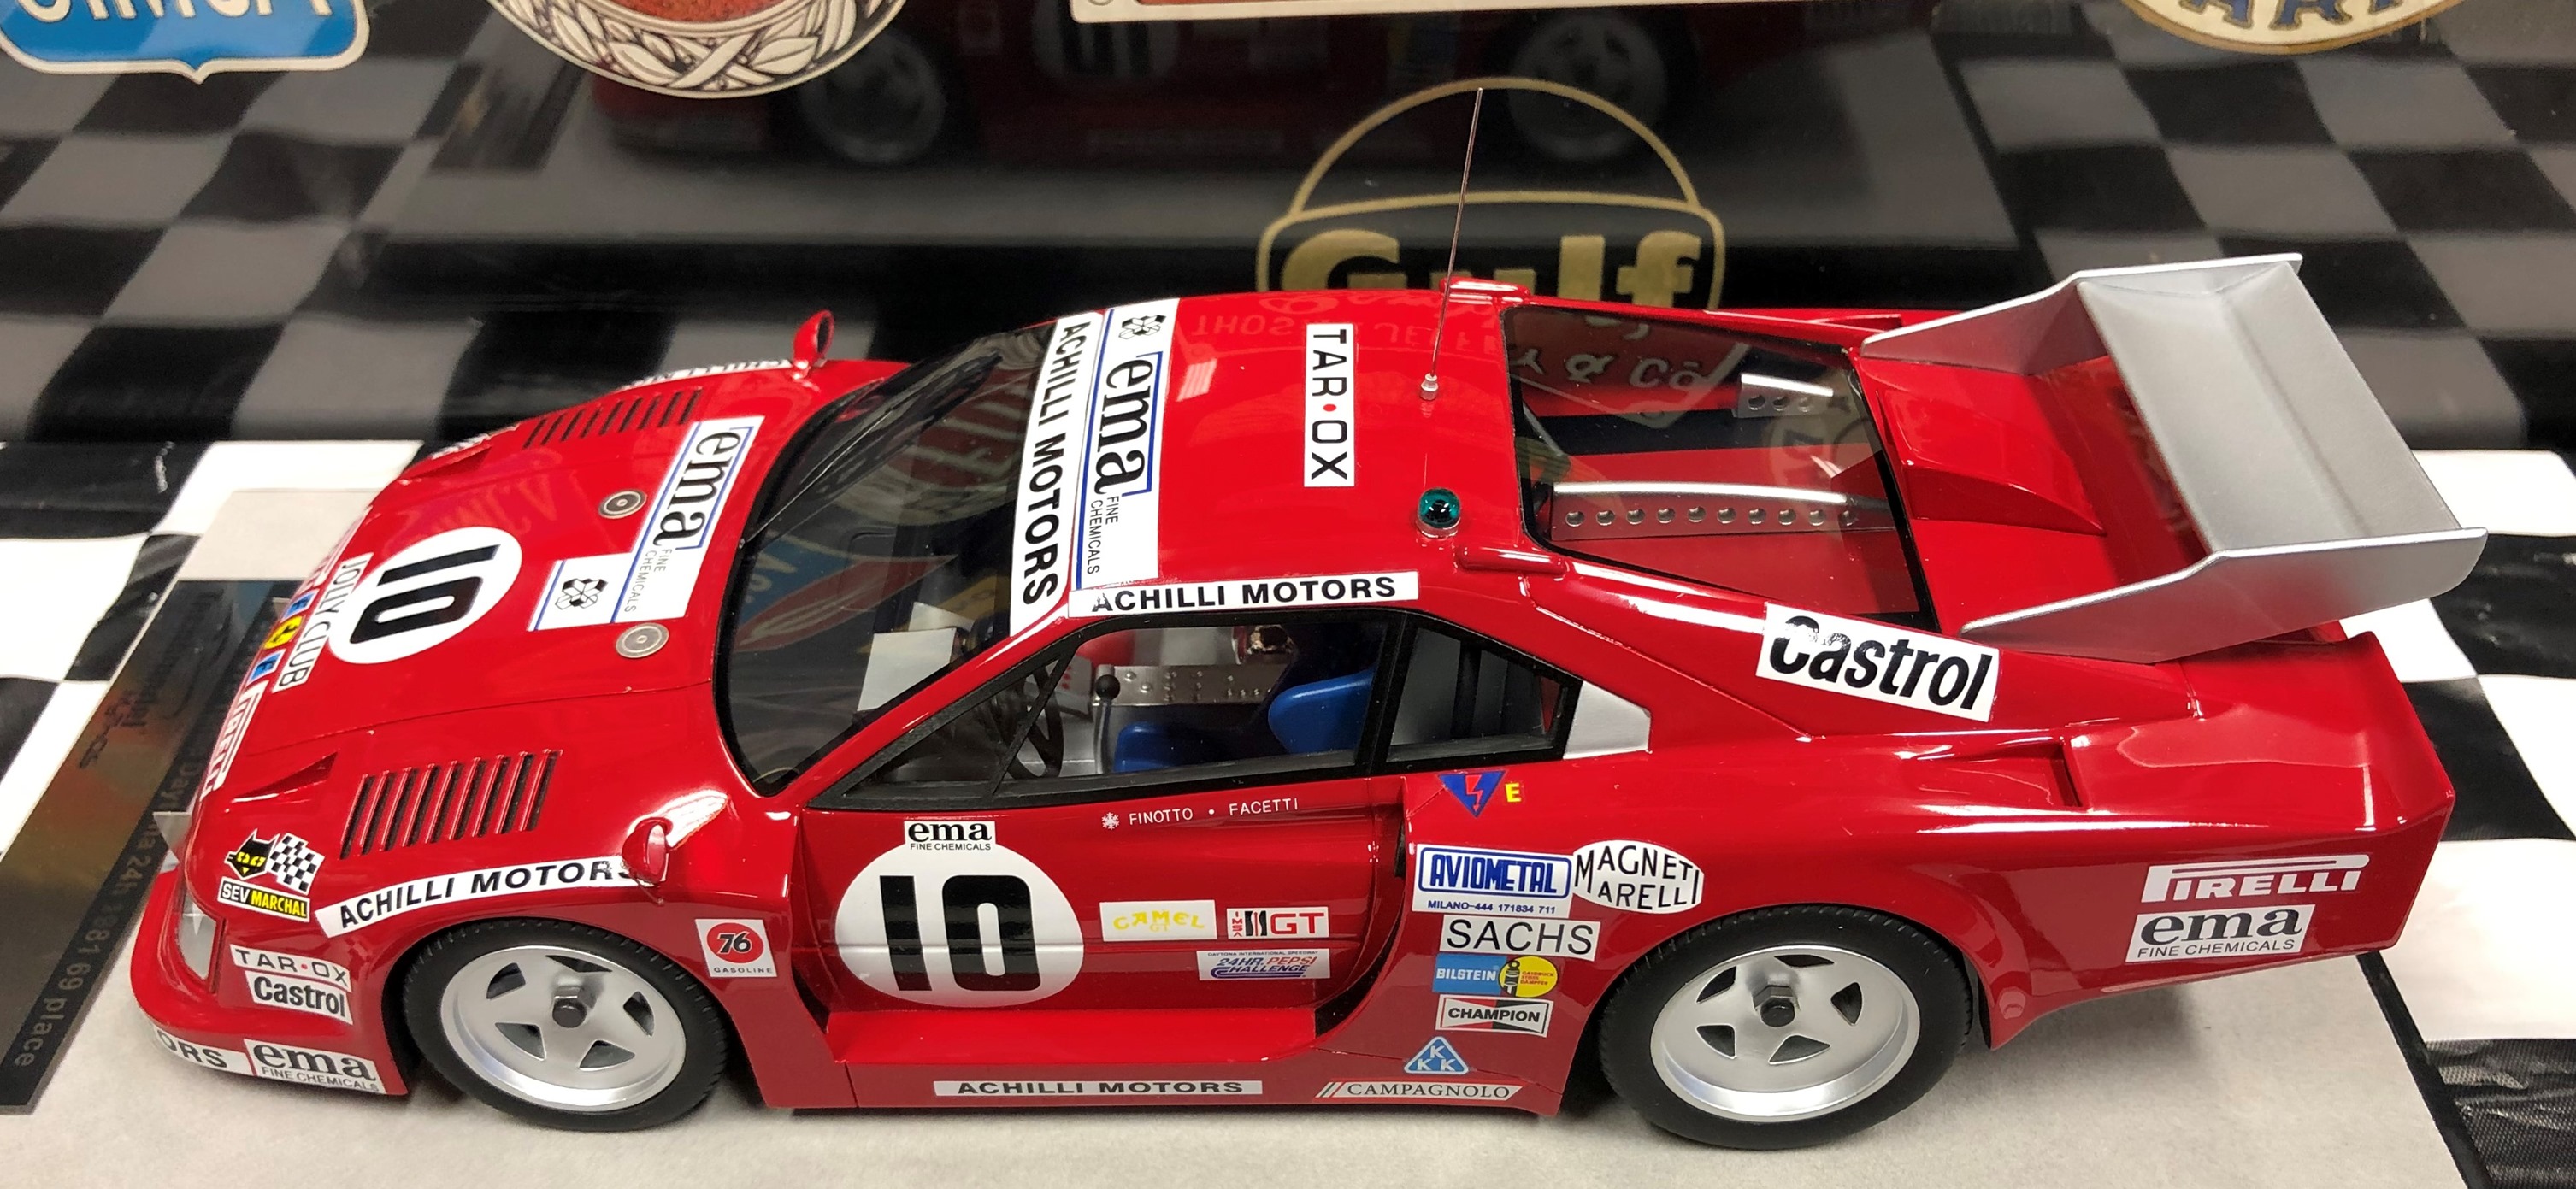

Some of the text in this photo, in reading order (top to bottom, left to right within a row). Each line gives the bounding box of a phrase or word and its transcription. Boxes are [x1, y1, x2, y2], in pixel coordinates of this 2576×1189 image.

[1095, 357, 1154, 496] ema
[1022, 321, 1092, 606] ACHILLI MOTORS
[653, 430, 741, 547] ema
[1105, 497, 1119, 524] FINE
[1087, 500, 1103, 575] CHEMICALS
[653, 550, 673, 573] FINE
[315, 559, 368, 616] JOLLY
[349, 544, 501, 645] 10
[623, 550, 658, 614] CHEMICALS
[1092, 577, 1397, 612] ACHILLI MOTORS
[279, 621, 332, 687] CLUB
[1768, 615, 1991, 711] Castrol
[1505, 783, 1522, 803] E
[1129, 798, 1300, 825] FINOTTO FACETTI
[909, 822, 993, 843] ema
[1430, 854, 1557, 893] AVIOMETAL
[2141, 854, 2371, 903] PIRELLI
[221, 883, 308, 919] SEV MARCHAL
[340, 877, 455, 929] ACHILLI
[1538, 904, 1556, 914] 711
[879, 874, 1041, 992] 10
[1112, 909, 1205, 931] CAMEL
[1270, 912, 1325, 935] GT
[1447, 919, 1595, 955] SACHS
[2140, 909, 2302, 945] ema
[716, 933, 752, 954] 76
[1267, 956, 1317, 965] PEPSI
[2137, 939, 2296, 959] FINE CHEMICALS
[1211, 964, 1310, 979] CHALLENGE
[1436, 968, 1496, 981] BILSTEIN
[253, 976, 346, 1017] Castrol
[15, 997, 65, 1067] place
[1448, 1007, 1541, 1023] CHAMPION
[252, 1043, 377, 1082] ema
[262, 1068, 380, 1093] FINE CHEMICALS
[957, 1080, 1244, 1095] ACHILLI MOTORS
[1347, 1083, 1510, 1099] CAMPAGNOLO
